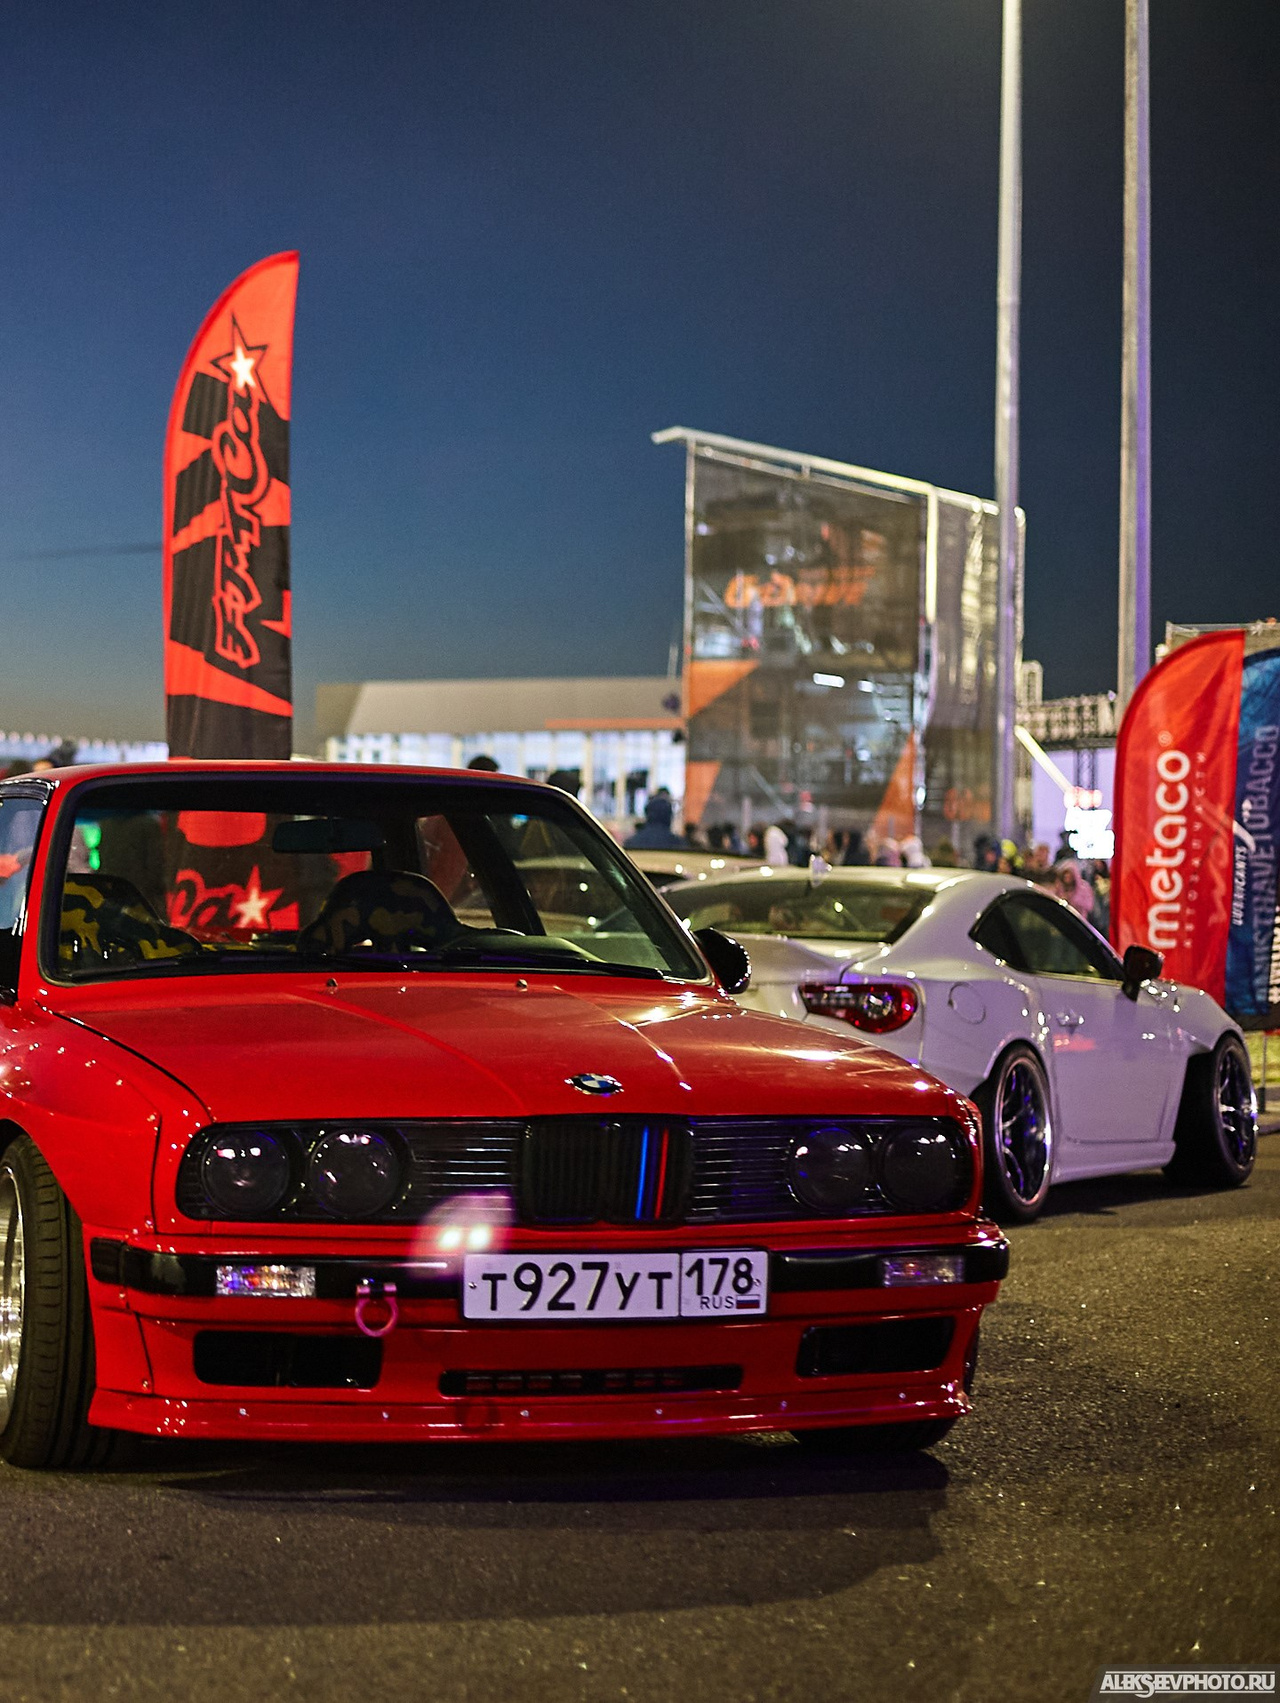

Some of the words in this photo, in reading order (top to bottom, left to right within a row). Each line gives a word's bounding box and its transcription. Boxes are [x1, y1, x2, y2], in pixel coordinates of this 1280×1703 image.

[1146, 750, 1191, 950] metaco
[685, 1257, 753, 1296] 178
[700, 1295, 734, 1310] RUS
